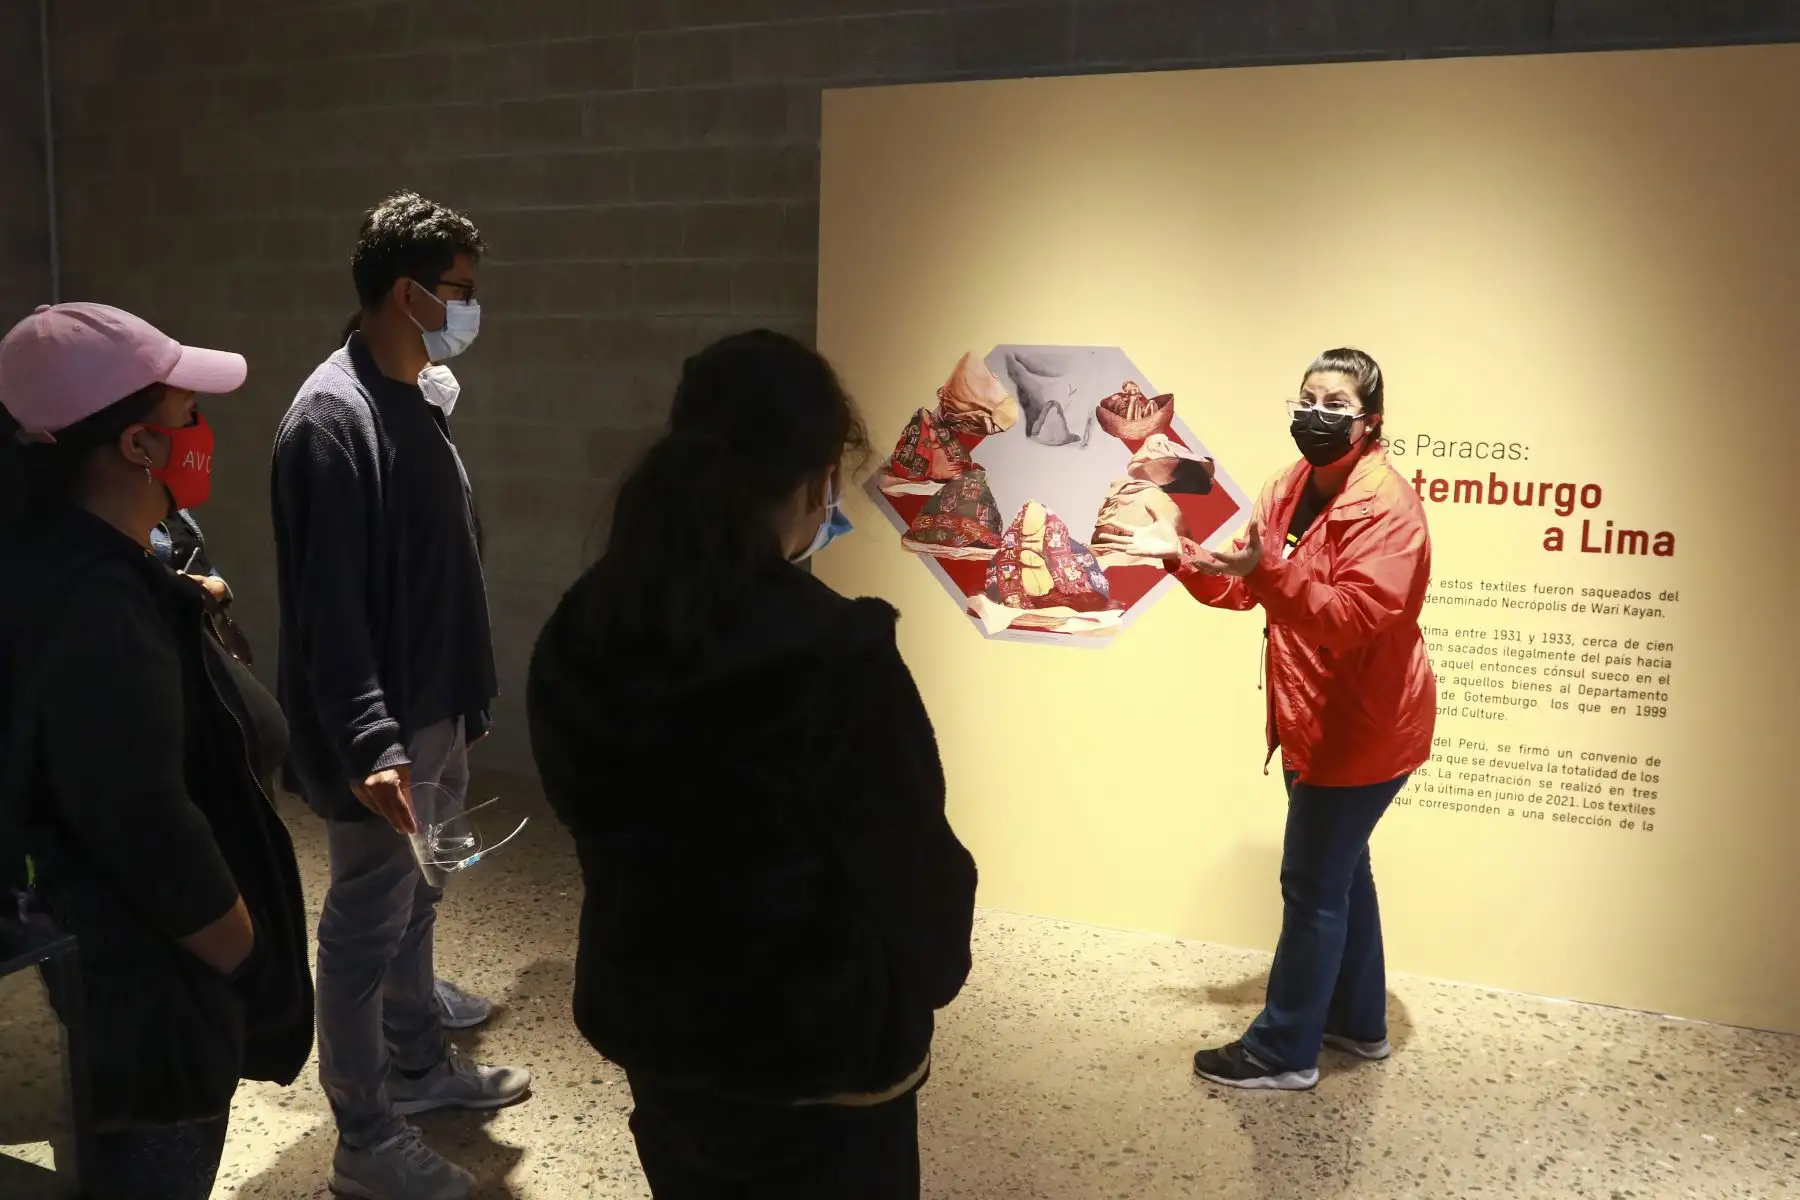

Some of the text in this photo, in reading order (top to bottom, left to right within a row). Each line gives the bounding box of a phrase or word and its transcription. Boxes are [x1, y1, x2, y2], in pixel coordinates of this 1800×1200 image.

[1416, 433, 1530, 461] Paracas:
[1411, 469, 1602, 516] temburgo
[1543, 519, 1675, 557] a Lima
[1440, 579, 1473, 590] estos
[1480, 580, 1526, 593] textiles
[1533, 583, 1574, 595] fueron
[1581, 586, 1652, 602] saqueados
[1658, 590, 1679, 602] del
[1424, 594, 1666, 619] denominado Necrópolis de Wari Kayan.
[1455, 629, 1487, 640] entre
[1493, 630, 1522, 642] 1931
[1528, 633, 1536, 644] y
[1542, 632, 1575, 646] 1933,
[1582, 638, 1618, 648] cerca
[1624, 638, 1639, 650] de
[1646, 640, 1674, 652] cien
[1448, 642, 1498, 656] sacados
[1502, 646, 1576, 662] ilegalmente
[1581, 652, 1600, 663] del
[1605, 652, 1632, 667] país
[1637, 656, 1672, 669] hacia
[1440, 658, 1474, 671] aquel
[1480, 662, 1537, 675] entonces
[1543, 665, 1585, 678] cónsul
[1591, 670, 1630, 682] sueco
[1636, 673, 1652, 684] en
[1658, 674, 1670, 685] el
[1452, 675, 1504, 690] aquellos
[1511, 680, 1552, 692] bienes
[1560, 684, 1571, 694] al
[1578, 684, 1668, 702] Departamento
[1441, 690, 1456, 700] de
[1550, 699, 1569, 710] los
[1578, 703, 1601, 714] que
[1610, 704, 1626, 714] en
[1635, 705, 1666, 718] 1999
[1462, 707, 1508, 720] Culture.
[1433, 736, 1452, 747] del
[1497, 743, 1511, 752] se
[1519, 744, 1550, 756] firmó
[1558, 750, 1572, 758] un
[1580, 751, 1638, 765] convenio
[1645, 756, 1661, 767] de
[1431, 753, 1660, 783] ra que se devuelva la totalidad de los
[1438, 768, 1451, 779] La
[1458, 771, 1531, 786] repatriación
[1538, 778, 1552, 788] se
[1560, 780, 1602, 794] realizó
[1609, 786, 1624, 796] en
[1632, 787, 1658, 800] tres
[1414, 784, 1421, 794] y
[1424, 782, 1434, 792] la
[1477, 788, 1492, 798] en
[1495, 790, 1524, 802] junio
[1528, 792, 1542, 804] de
[1546, 794, 1579, 808] 2021.
[1582, 796, 1604, 810] Los
[1608, 799, 1656, 815] textiles
[1391, 796, 1654, 832] quí corresponden a una selección de la
